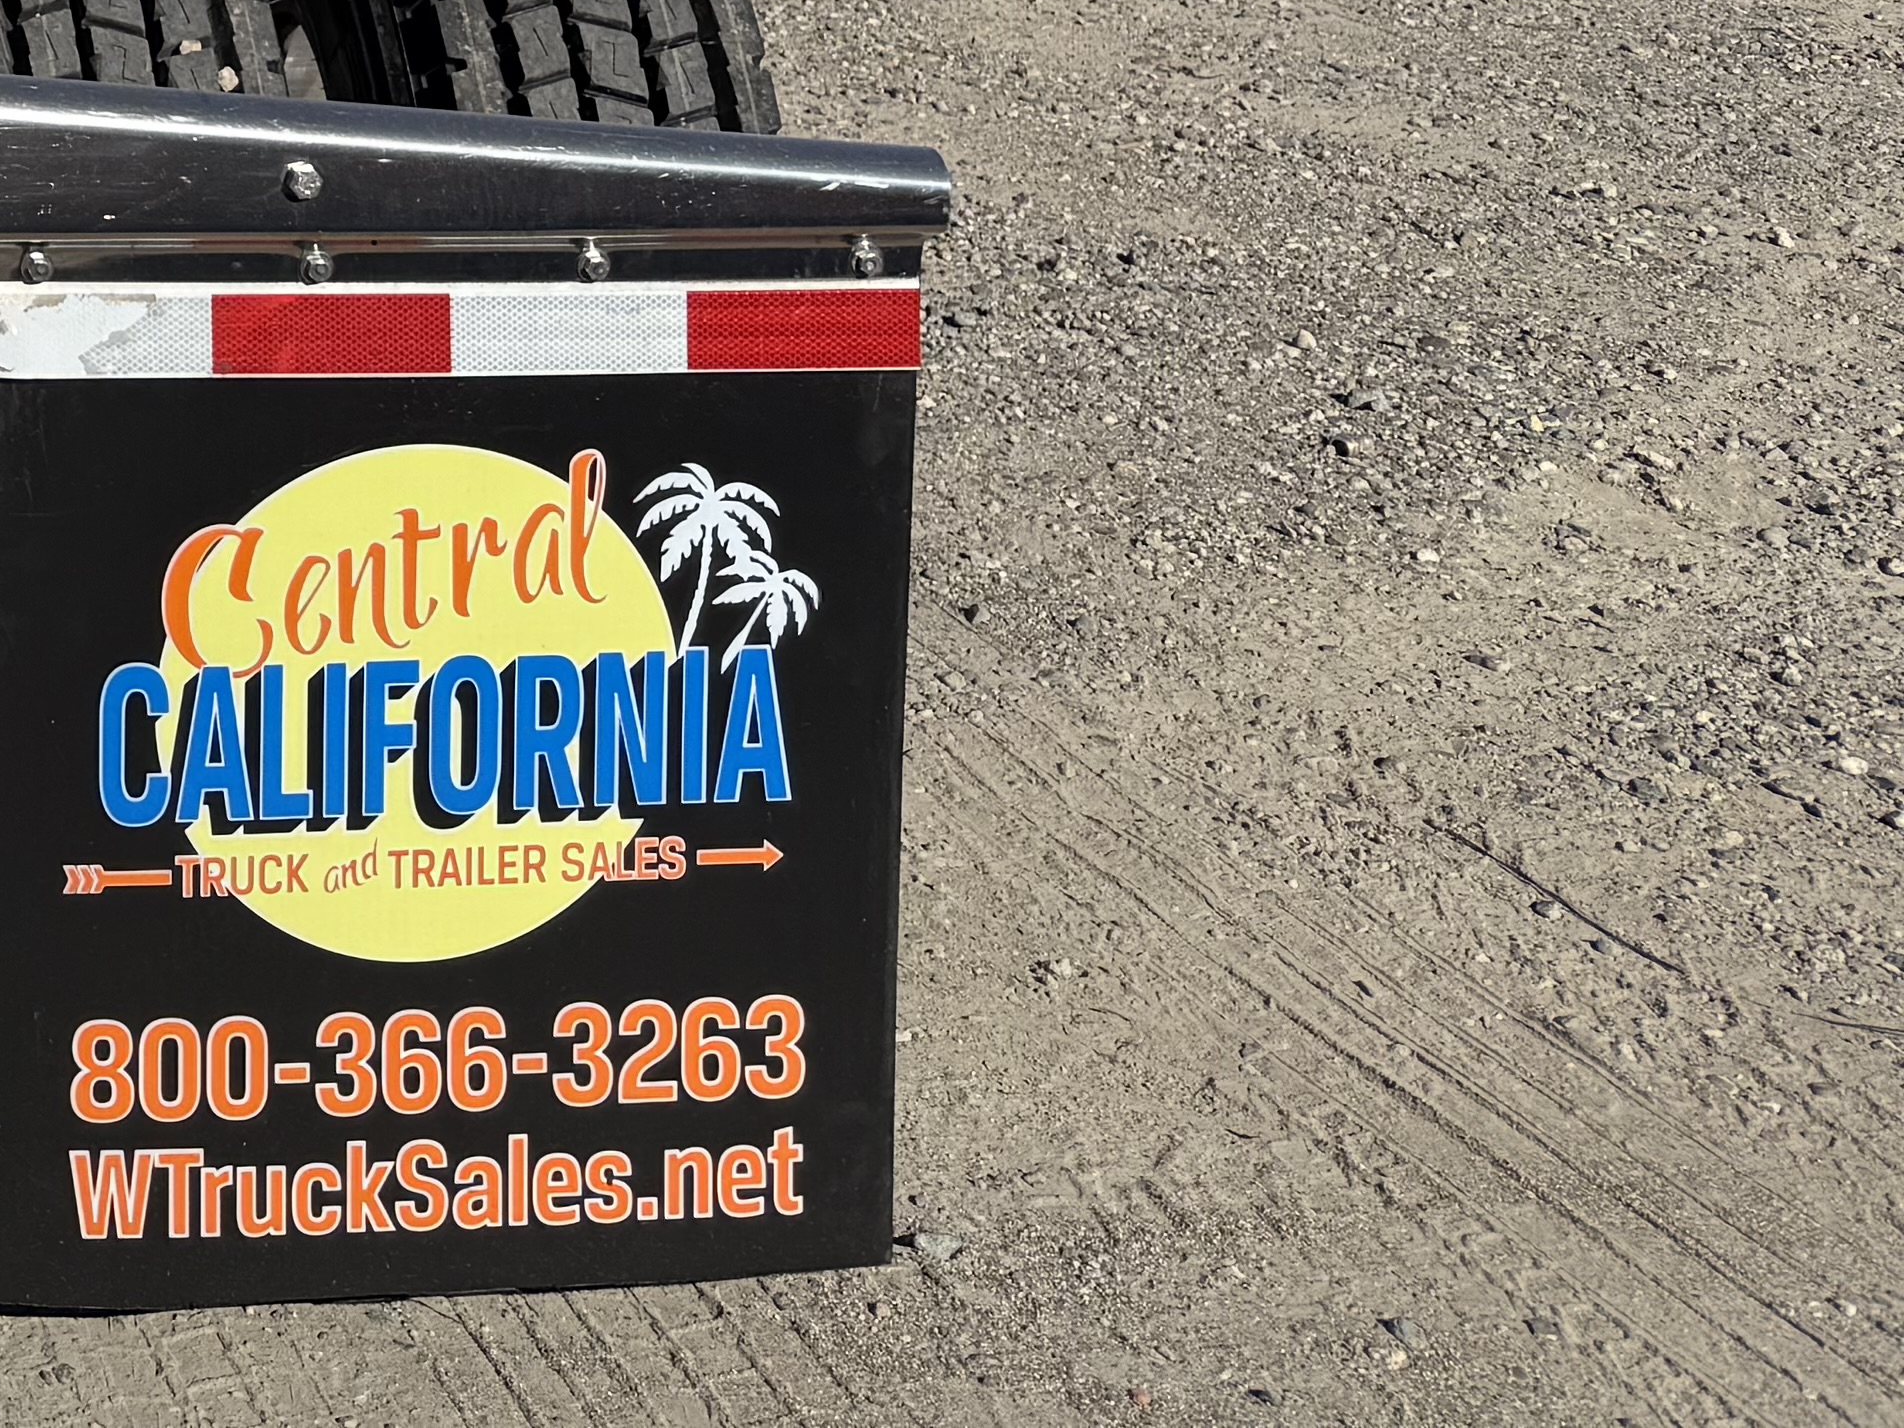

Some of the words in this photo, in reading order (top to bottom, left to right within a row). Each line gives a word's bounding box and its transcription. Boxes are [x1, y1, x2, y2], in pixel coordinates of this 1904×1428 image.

[162, 447, 608, 681] Central
[97, 643, 793, 832] CALIFORNIA
[176, 851, 308, 899] TRUCK
[323, 841, 379, 896] and
[387, 842, 548, 889] TRAILER
[560, 836, 687, 885] SALES
[70, 994, 807, 1125] 800-366-3263
[69, 1126, 805, 1243] WTruckSales.net
